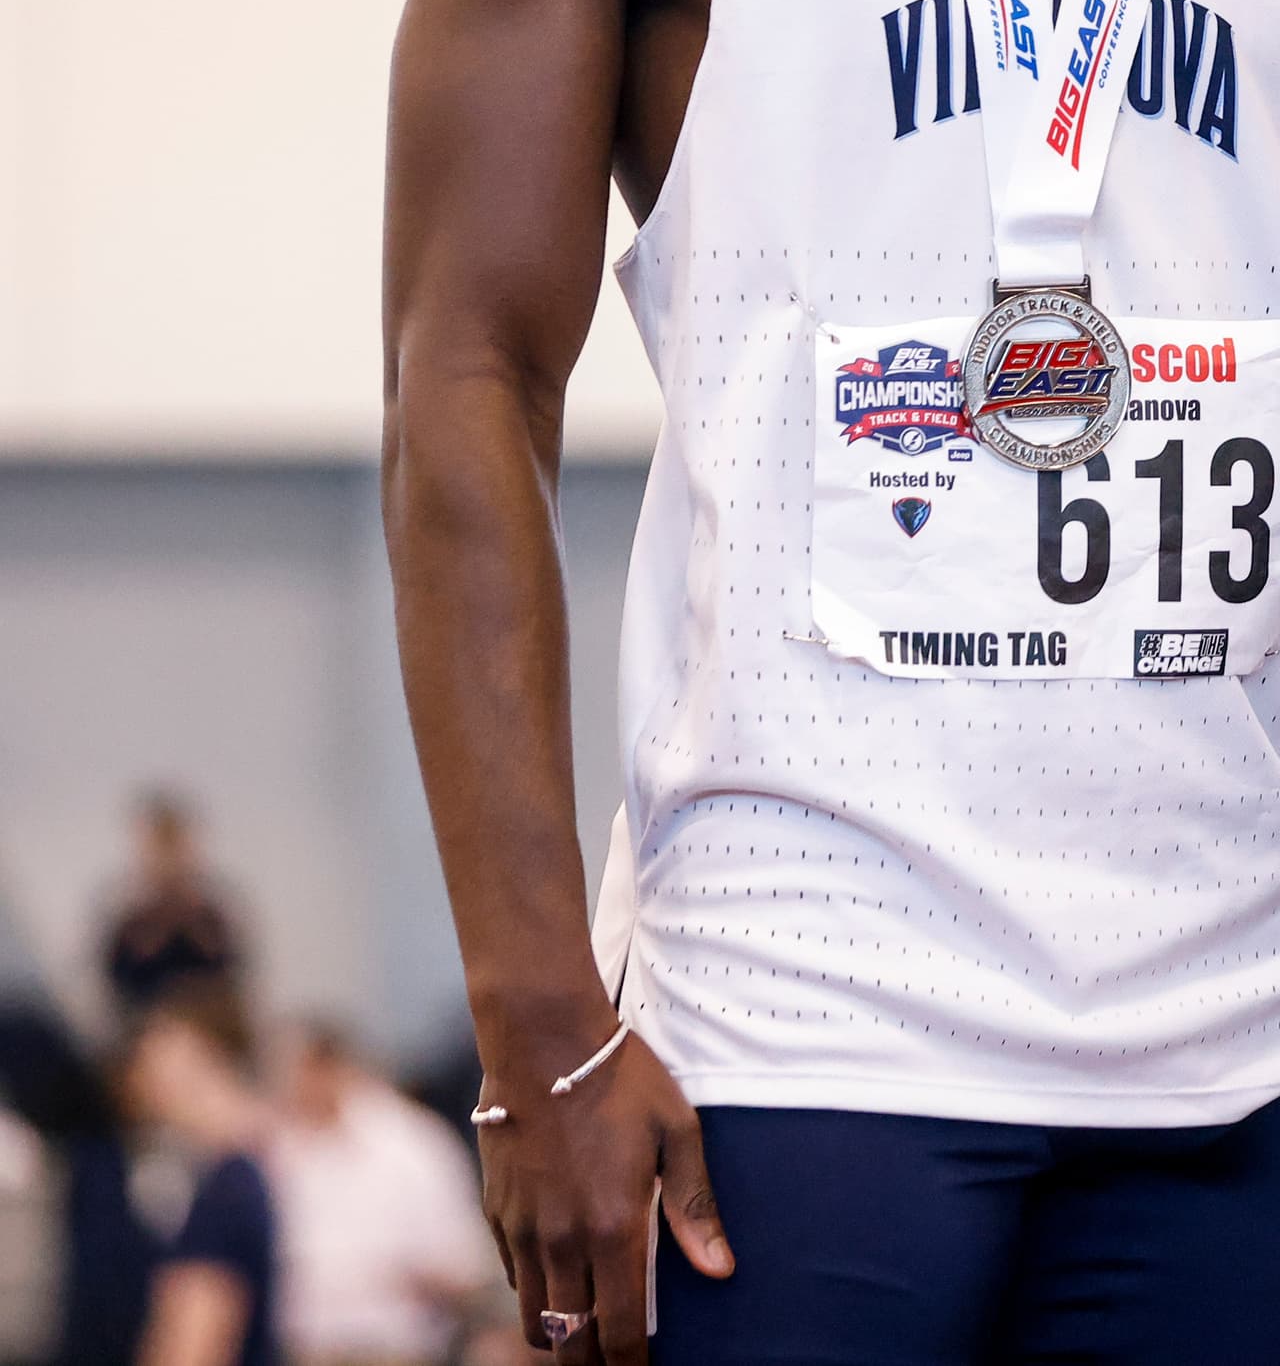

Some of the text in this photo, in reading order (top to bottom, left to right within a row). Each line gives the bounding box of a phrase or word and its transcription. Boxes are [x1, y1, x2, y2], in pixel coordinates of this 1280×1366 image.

[972, 298, 1118, 364] INDOOR TRACK & FIELD
[861, 362, 874, 372] 20
[889, 359, 941, 370] EAST
[896, 348, 932, 359] BIG
[1001, 341, 1093, 370] BIG
[1132, 338, 1236, 382] scod
[839, 381, 962, 411] CHAMPIONSH
[987, 367, 1118, 398] EAST
[869, 412, 958, 425] TRACK & FIELD
[1124, 399, 1200, 421] anova
[990, 422, 1112, 463] CHAMPIONSHIPS
[870, 471, 955, 490] Hosted by
[1037, 437, 1275, 604] 613
[880, 631, 1067, 666] TIMING TAG
[1137, 655, 1224, 674] CHANGE
